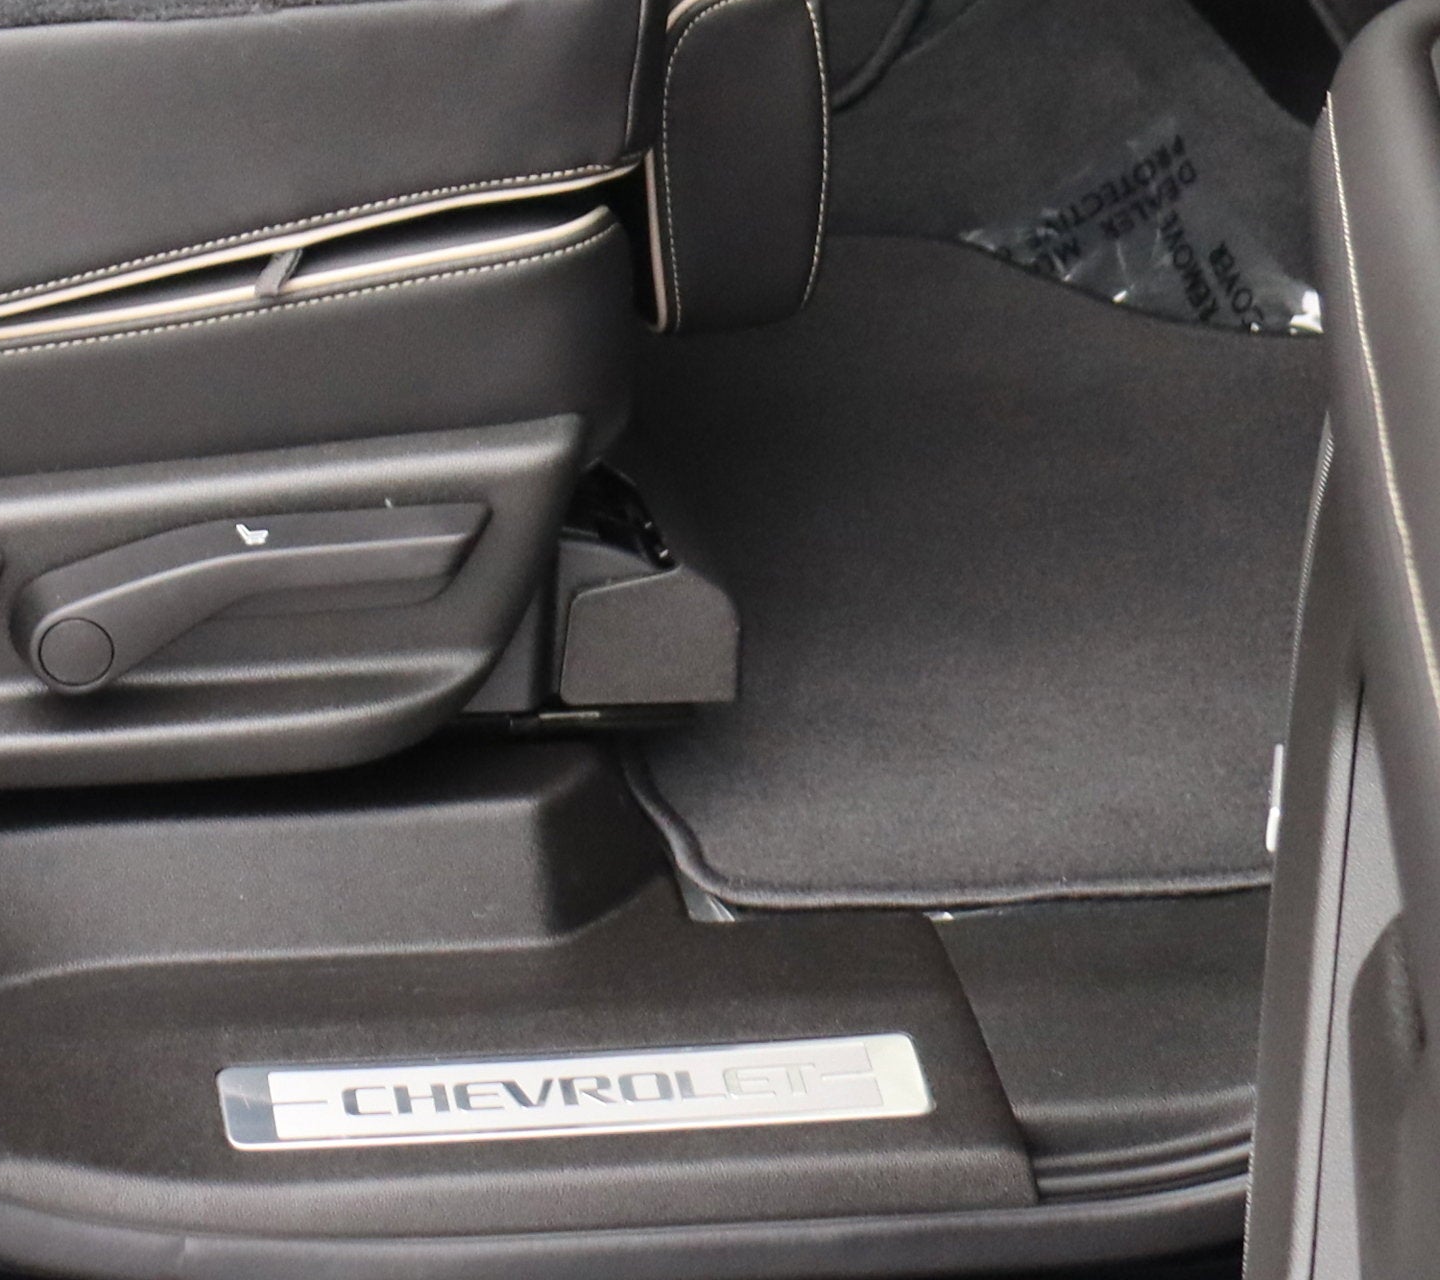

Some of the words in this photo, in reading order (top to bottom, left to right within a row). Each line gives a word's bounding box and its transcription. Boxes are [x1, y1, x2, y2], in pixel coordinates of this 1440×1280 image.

[1102, 159, 1197, 238] DEALER
[1208, 242, 1264, 329] COVER
[340, 1061, 816, 1116] CHEVROLET
